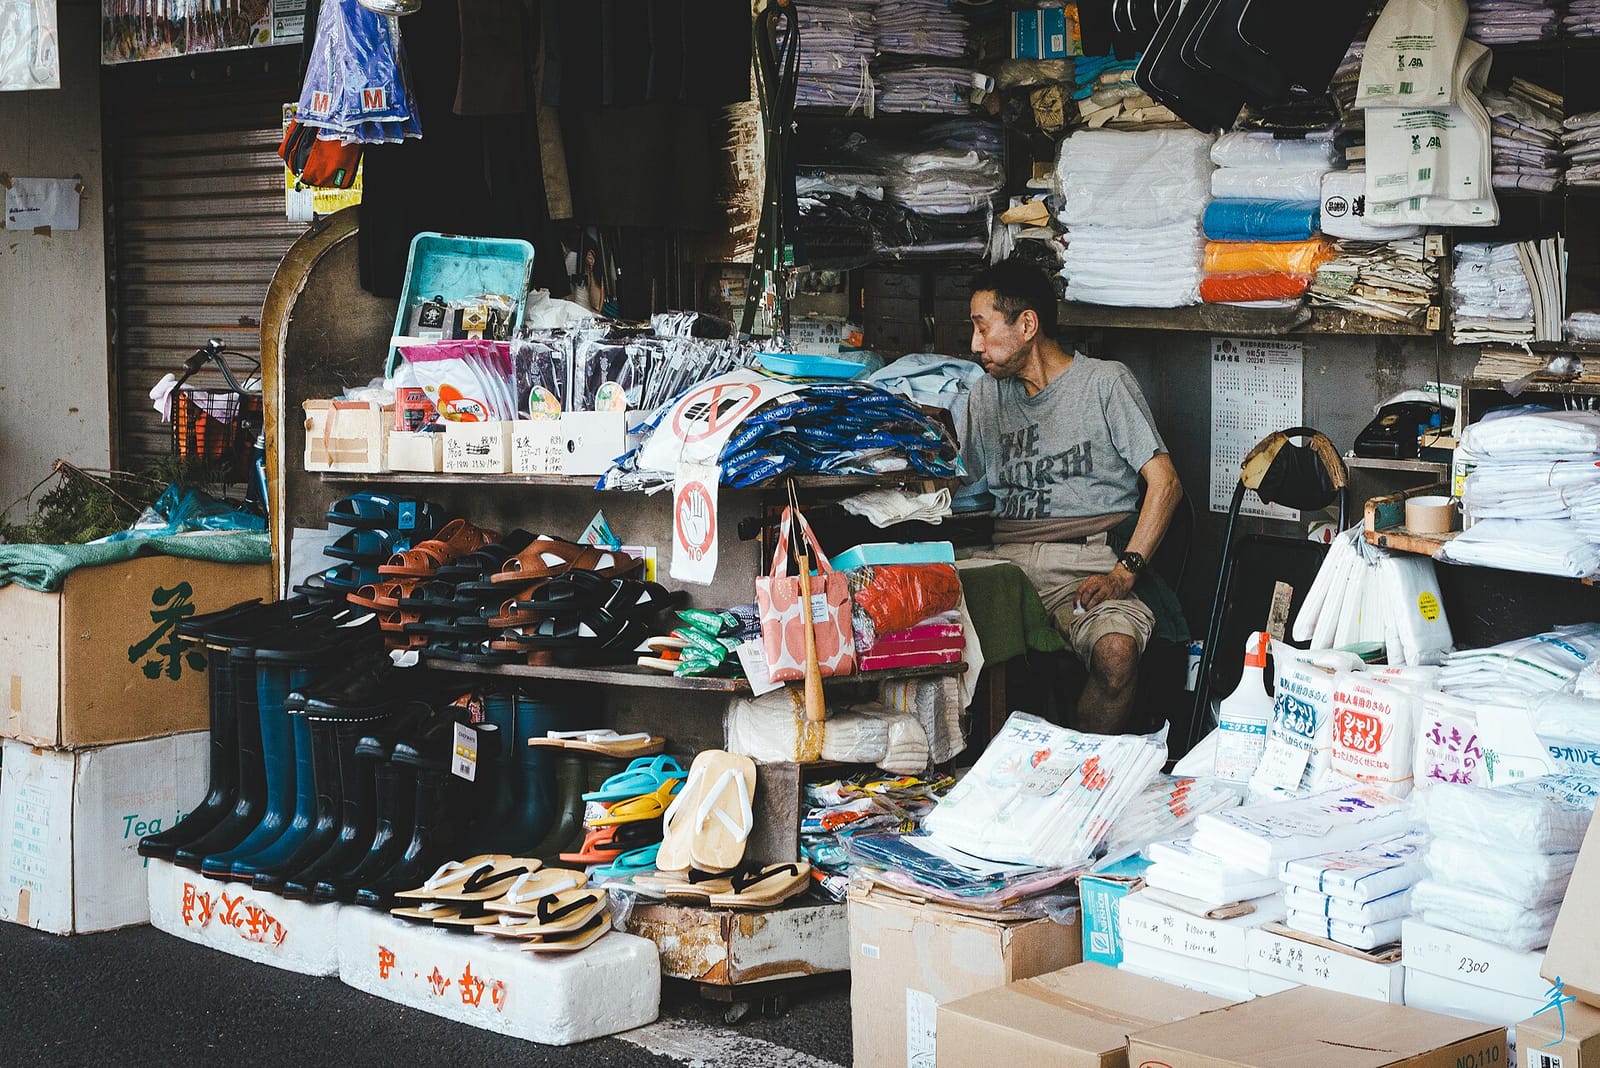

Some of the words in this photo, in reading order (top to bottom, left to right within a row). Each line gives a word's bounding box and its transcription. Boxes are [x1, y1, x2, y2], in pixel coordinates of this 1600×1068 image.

[313, 92, 329, 112] M
[363, 88, 383, 109] M
[1246, 348, 1266, 358] 令和5年
[1000, 423, 1040, 466] THE
[999, 440, 1093, 488] NORTH
[687, 547, 703, 562] NO
[127, 581, 208, 681] 茶
[1343, 711, 1378, 737] シャリ
[1007, 727, 1052, 743] フキフキ
[1064, 739, 1102, 752] フキフキ
[123, 814, 162, 839] Tea
[1458, 957, 1490, 974] 2300
